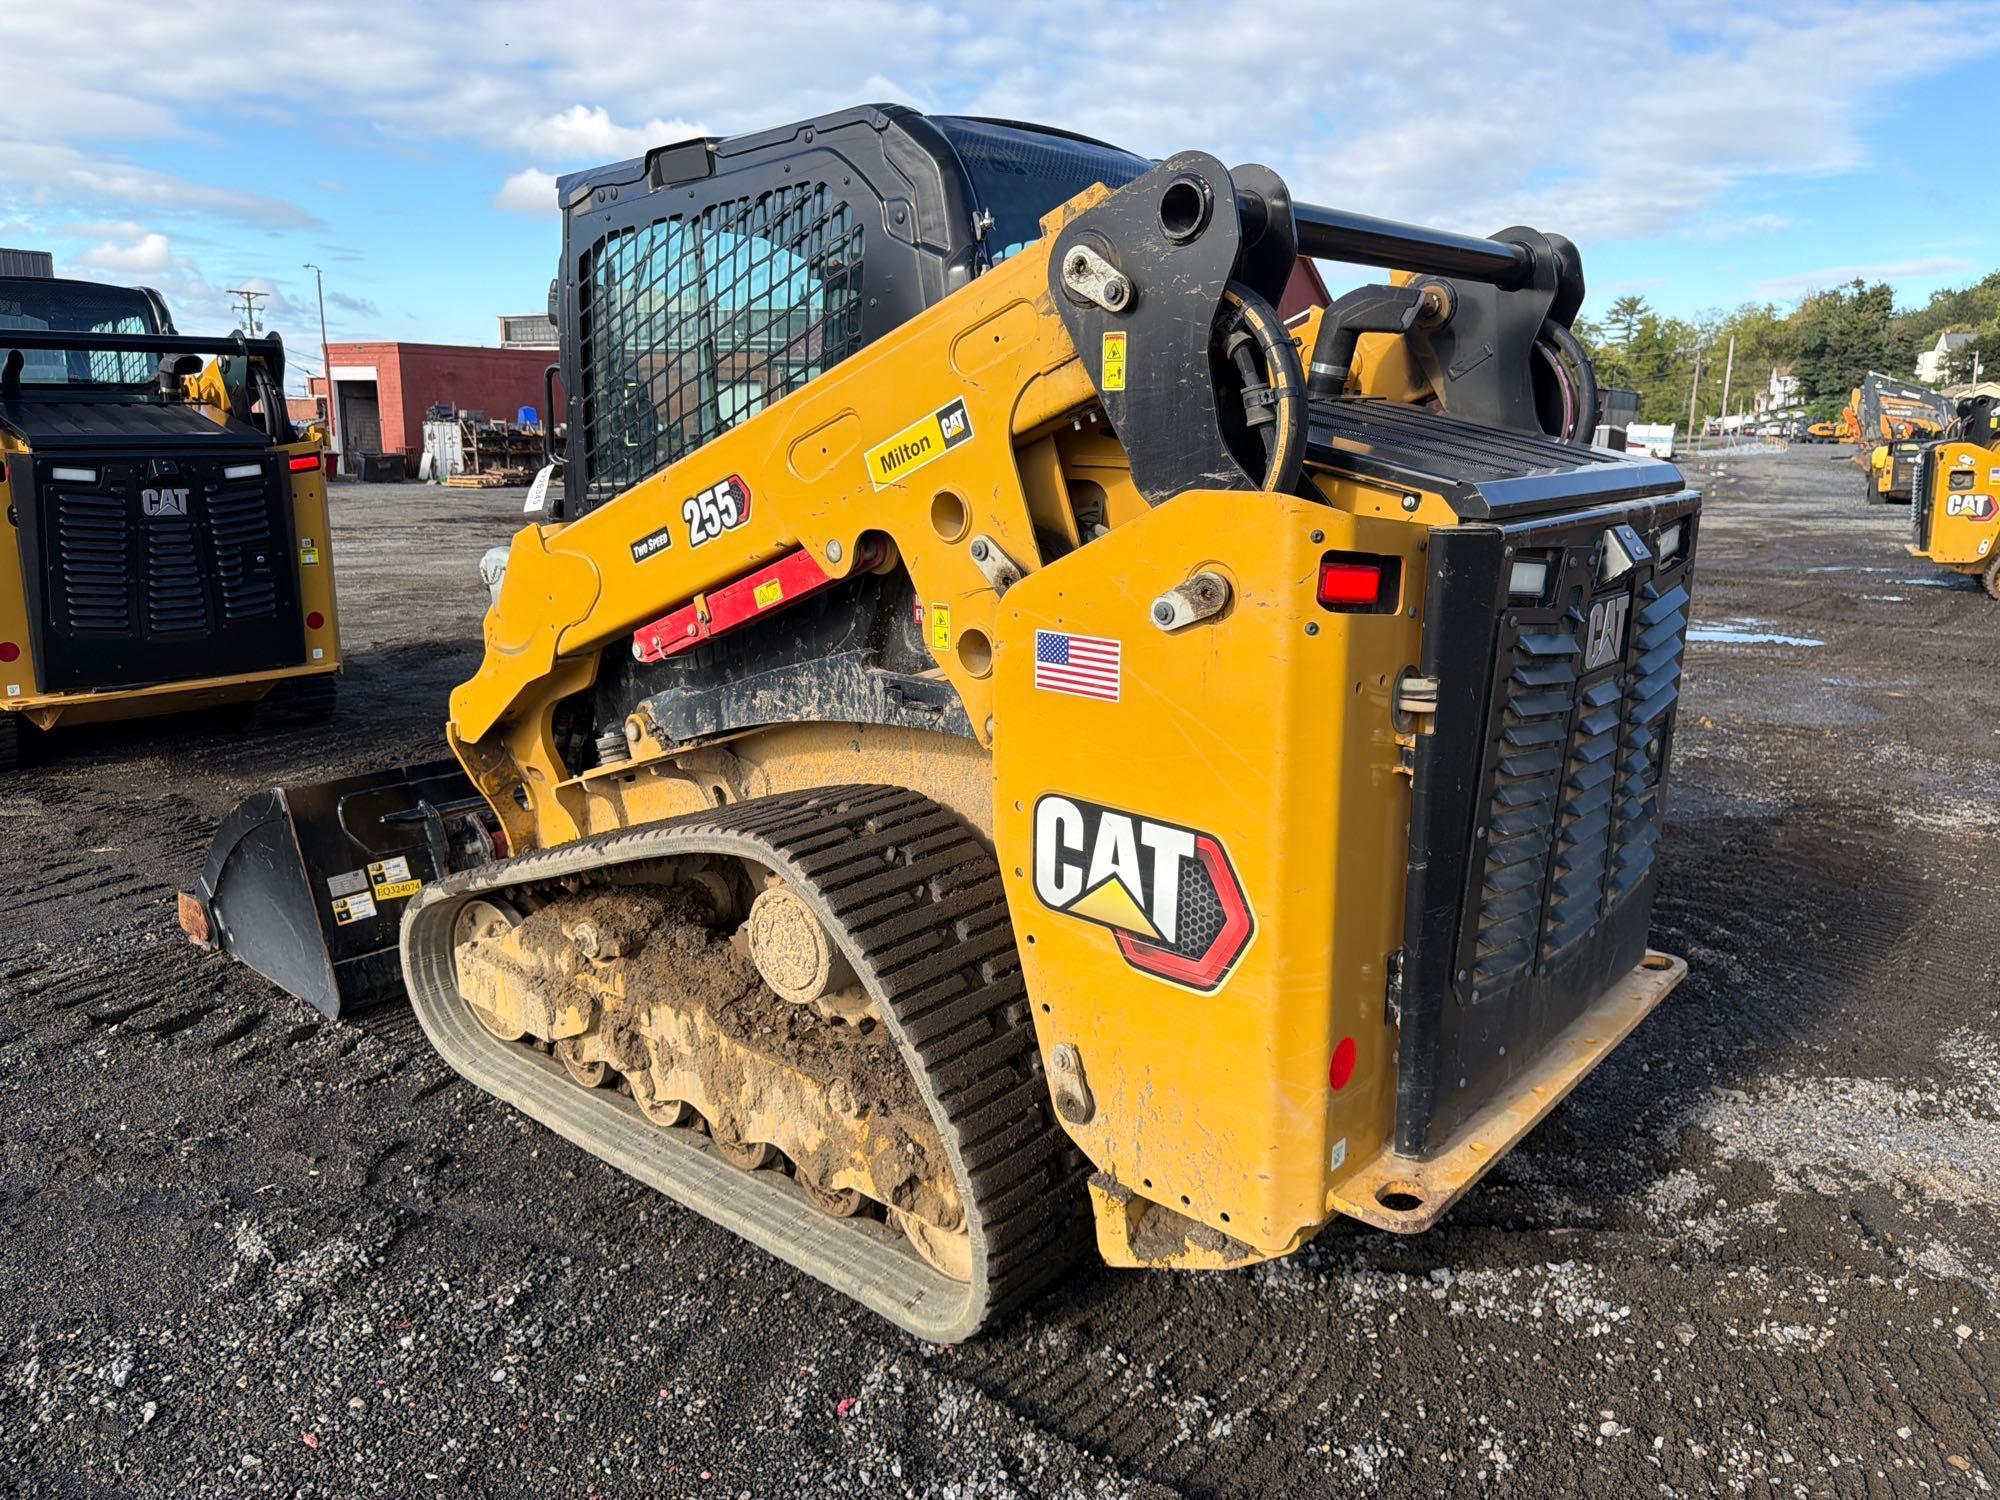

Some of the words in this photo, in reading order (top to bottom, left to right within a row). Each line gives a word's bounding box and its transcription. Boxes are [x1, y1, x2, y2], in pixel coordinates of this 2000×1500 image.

[880, 436, 931, 474] Milton
[940, 408, 965, 439] CAT
[142, 488, 190, 516] CAT
[683, 480, 738, 545] 255
[1947, 494, 1989, 516] CAT
[1584, 595, 1630, 669] CAT
[377, 882, 420, 897] EQ324074
[1036, 796, 1195, 944] CAT
